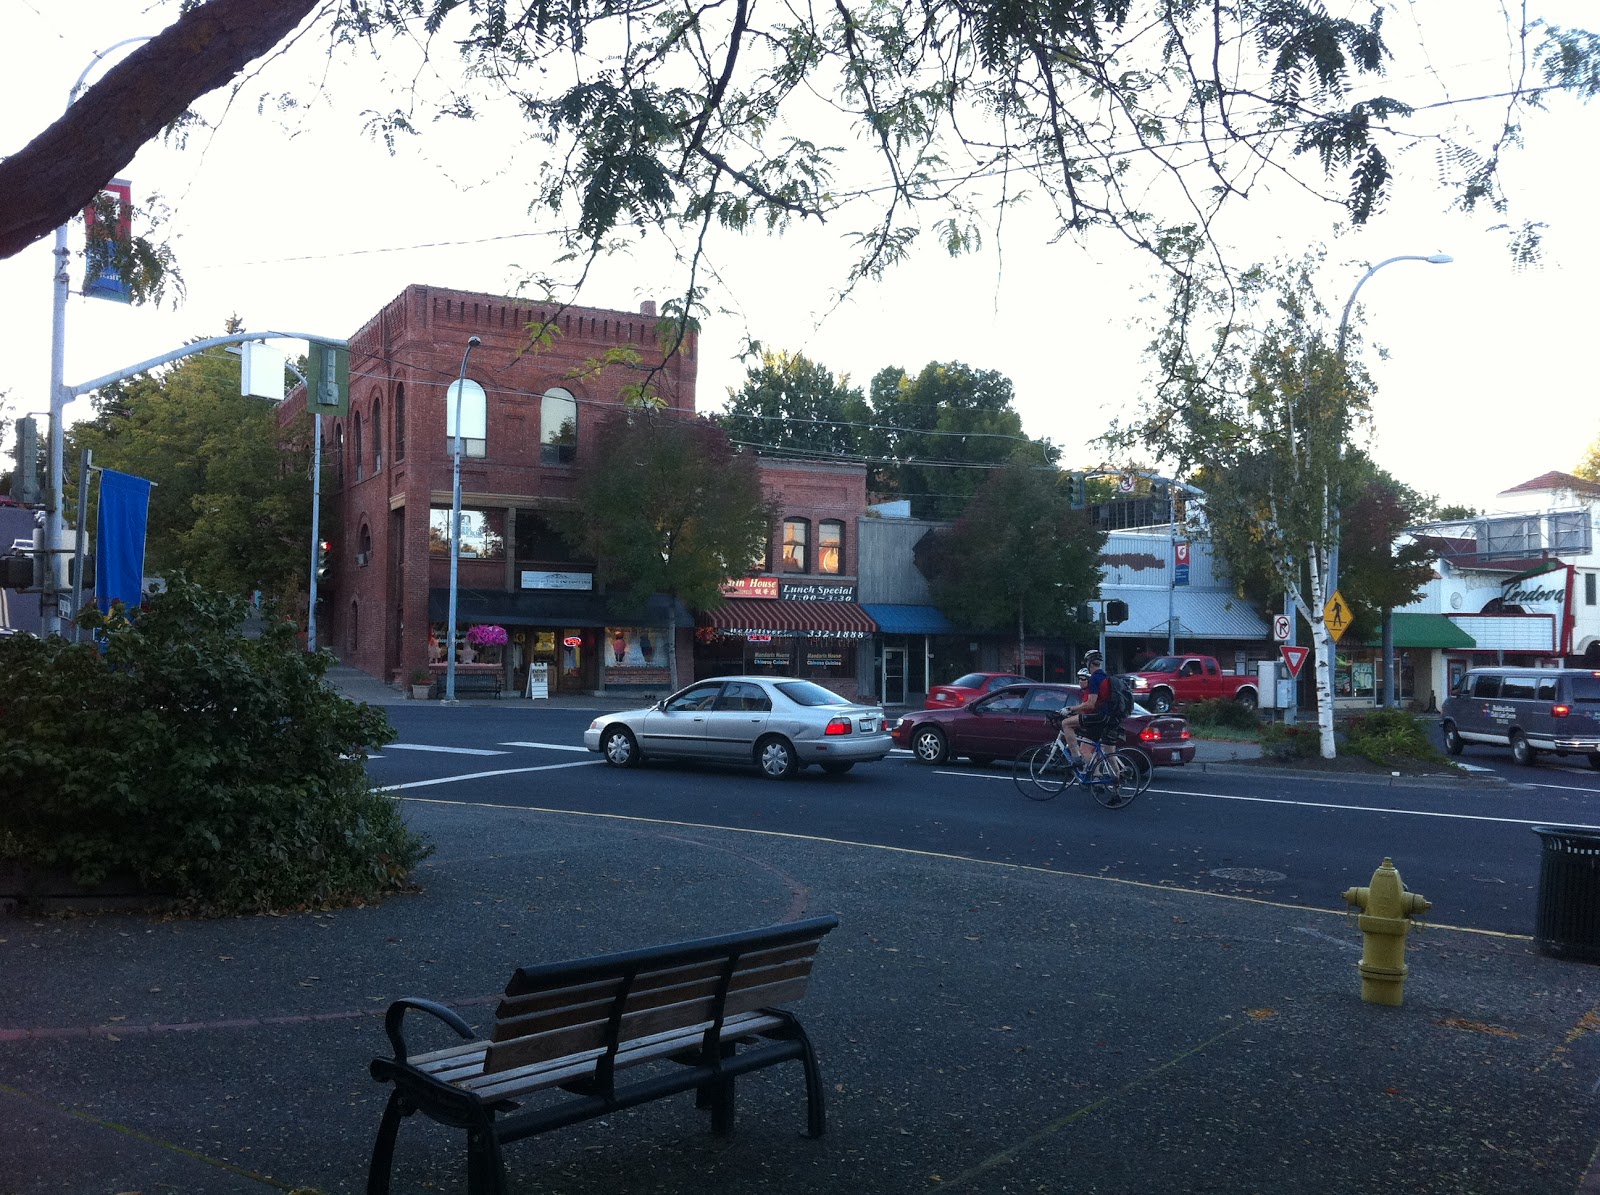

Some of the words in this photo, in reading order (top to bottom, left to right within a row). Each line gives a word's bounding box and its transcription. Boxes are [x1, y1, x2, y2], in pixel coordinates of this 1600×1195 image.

[749, 578, 777, 588] House
[783, 584, 815, 594] Lunch
[818, 586, 853, 596] Special
[1504, 582, 1565, 603] Cordova
[807, 630, 864, 638] 332-1888
